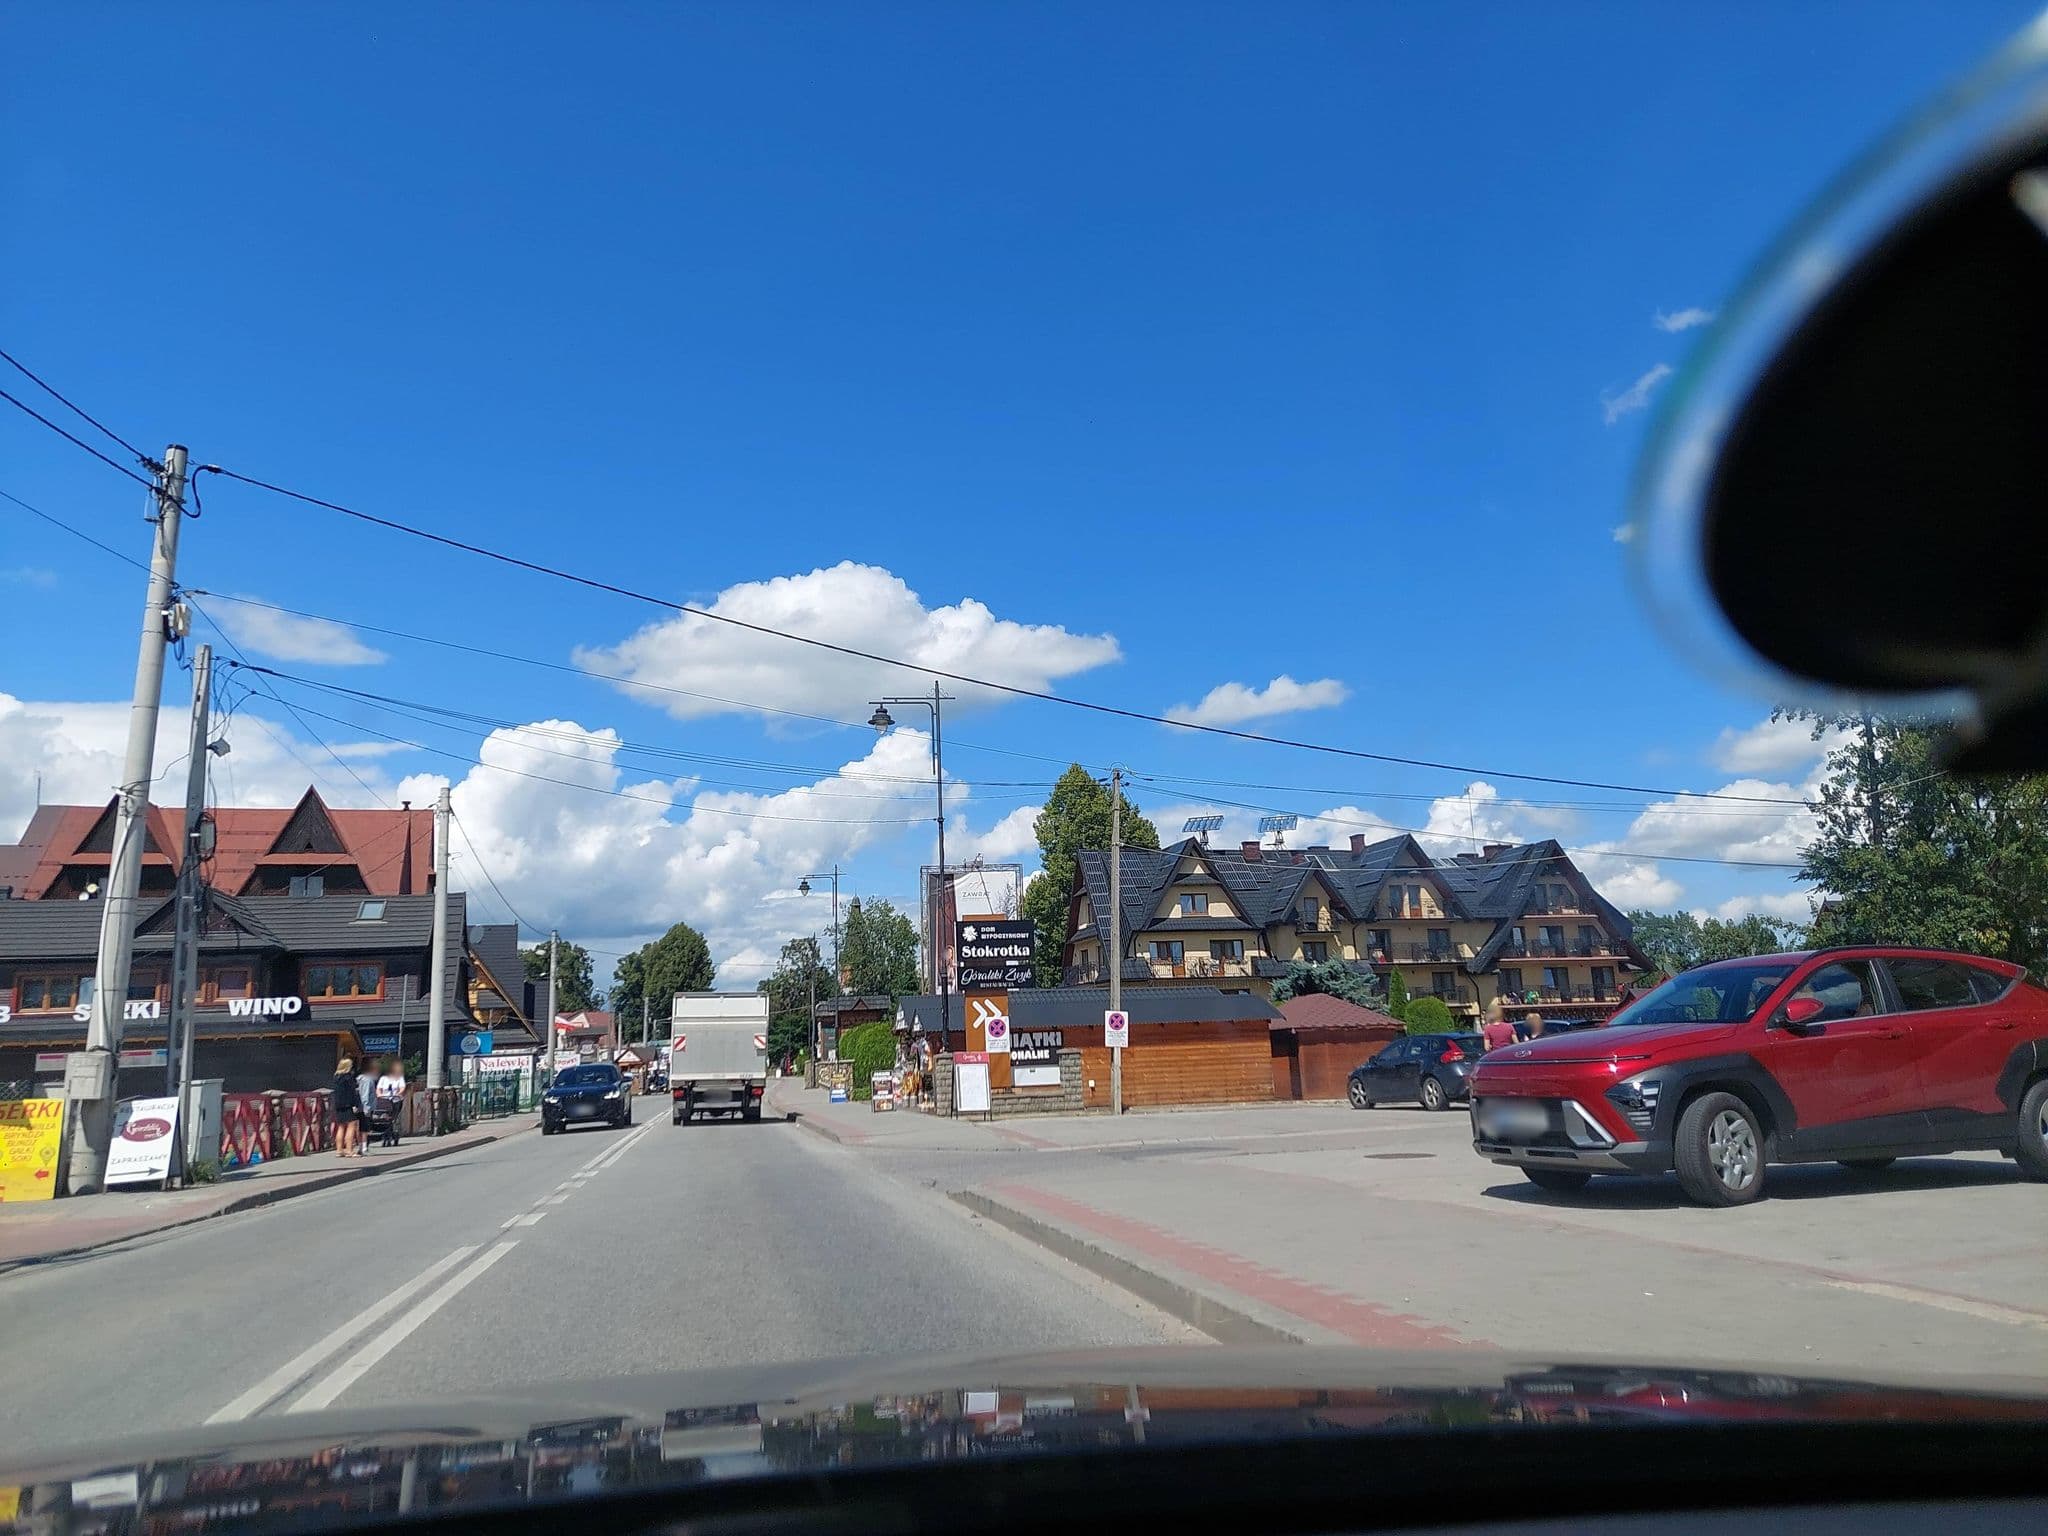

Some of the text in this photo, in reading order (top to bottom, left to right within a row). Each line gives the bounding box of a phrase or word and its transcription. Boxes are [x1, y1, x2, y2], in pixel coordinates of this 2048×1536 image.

[961, 944, 1031, 958] Stokrotka
[73, 1001, 161, 1021] SKI
[228, 996, 302, 1017] WINO
[1010, 1032, 1062, 1049] IĄTKI
[480, 1056, 530, 1068] Nalewki
